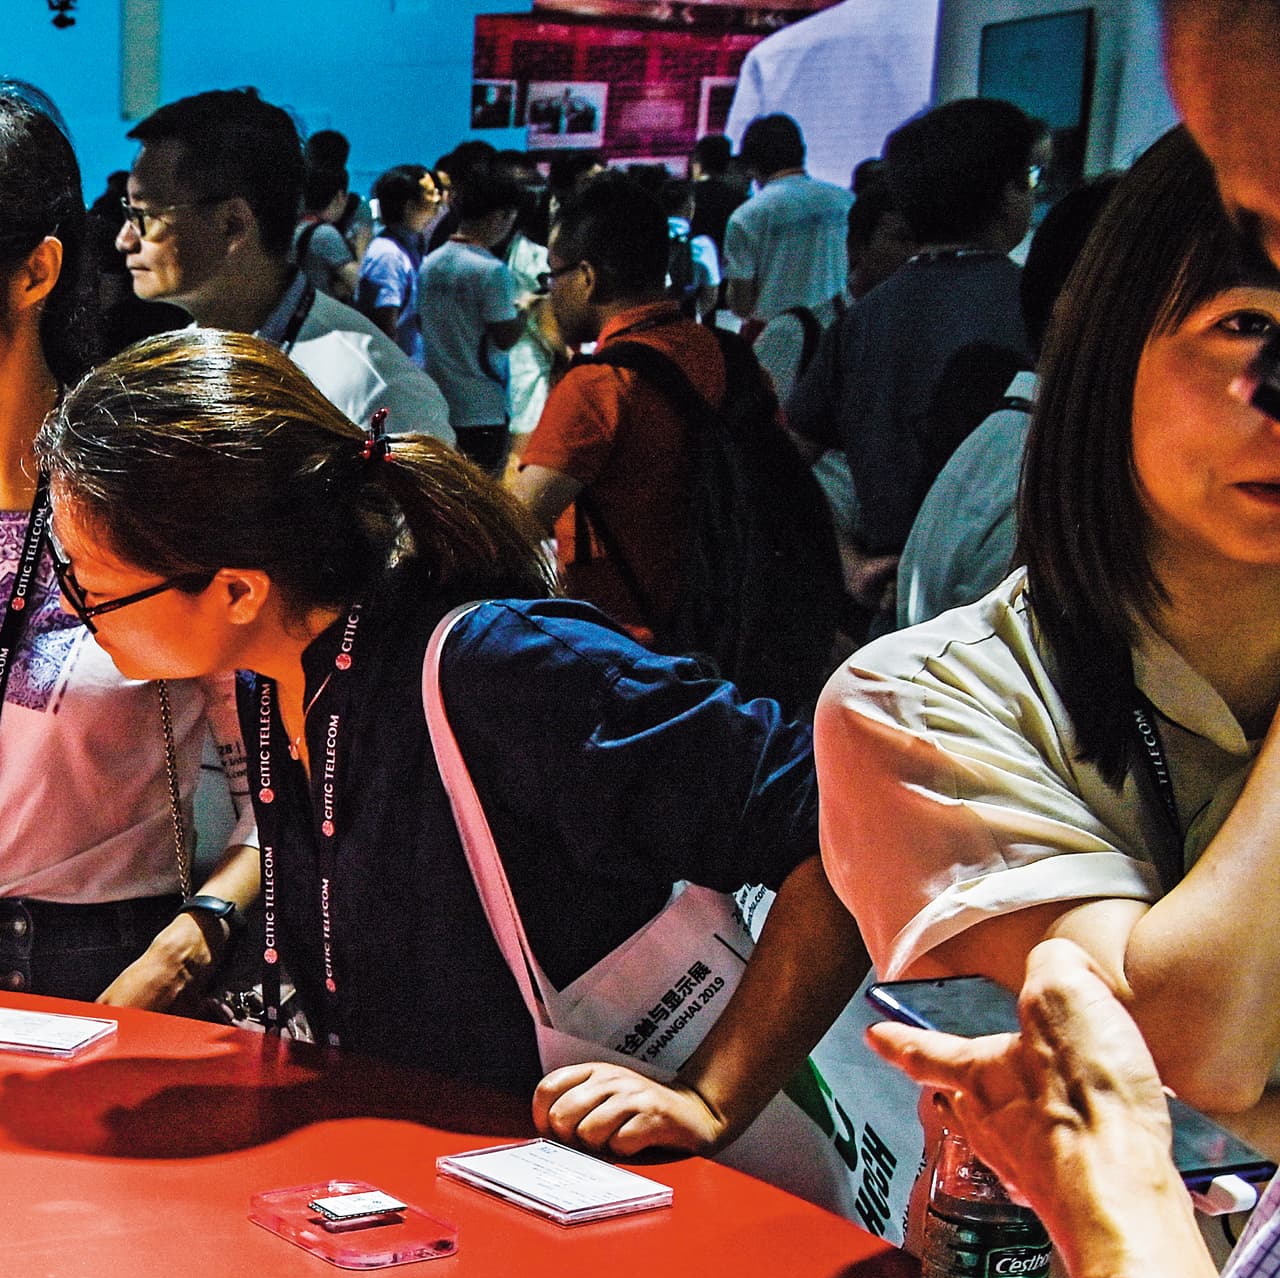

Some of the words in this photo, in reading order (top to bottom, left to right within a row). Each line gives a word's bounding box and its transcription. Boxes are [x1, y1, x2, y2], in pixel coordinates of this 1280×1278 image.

[16, 564, 33, 597] CITIC
[25, 508, 46, 562] TELECOM
[341, 612, 360, 653] CITIC
[260, 683, 272, 748] TELECOM
[260, 752, 271, 787] CITIC
[324, 714, 340, 780] TELECOM
[324, 783, 334, 820] CITIC
[264, 846, 275, 907] TELECOM
[265, 911, 276, 948] CITIC
[321, 878, 330, 938] TELECOM
[323, 942, 333, 978] CITIC
[646, 1000, 703, 1061] SHANGHAI
[698, 976, 726, 1005] 2019
